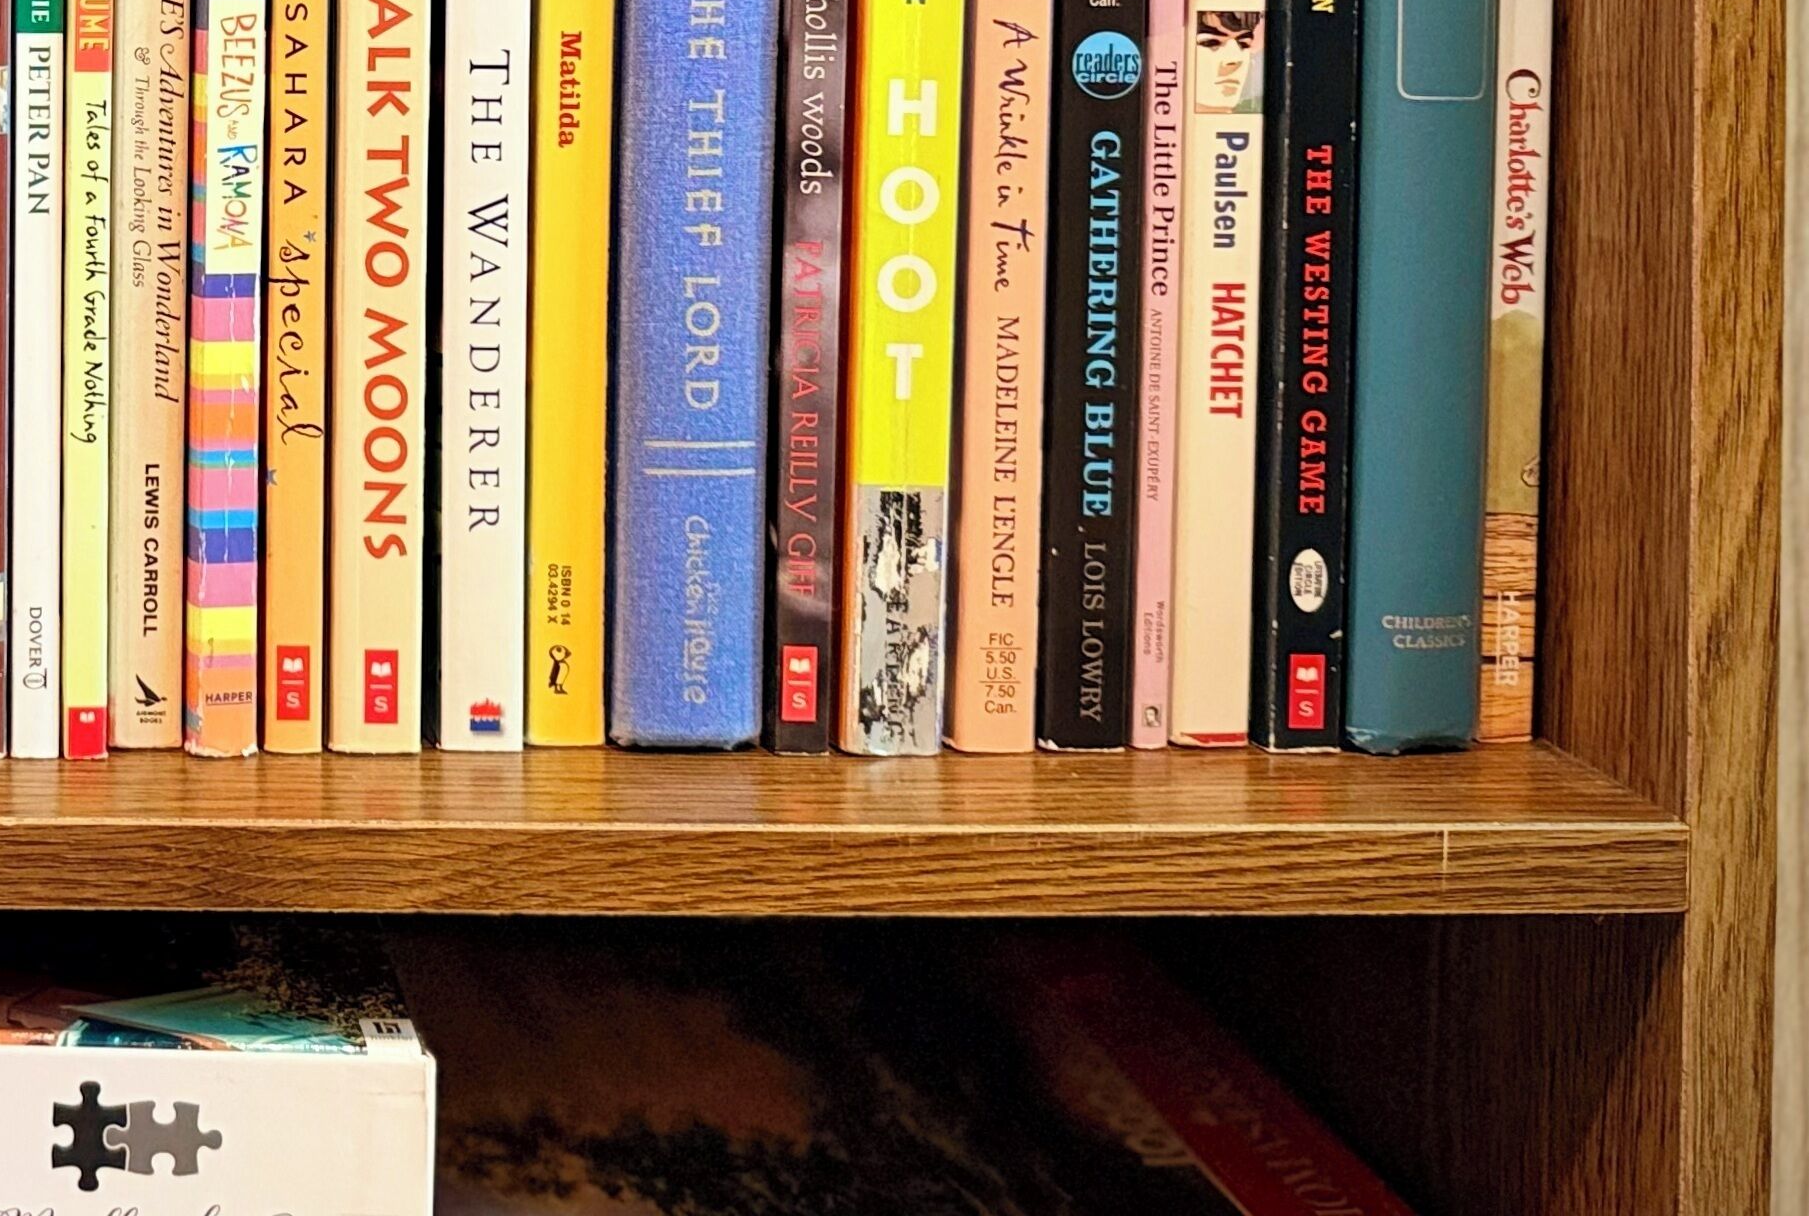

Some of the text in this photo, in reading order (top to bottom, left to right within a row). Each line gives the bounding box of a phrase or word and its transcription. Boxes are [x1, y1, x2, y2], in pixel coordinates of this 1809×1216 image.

[28, 45, 51, 215] PETER PAN
[158, 44, 185, 195] Adventures
[284, 2, 308, 204] SAHARA
[558, 31, 583, 148] Matilda
[1076, 44, 1140, 74] readers
[1076, 71, 1138, 85] circle
[128, 75, 152, 288] Through the Looking Glass
[213, 13, 258, 251] BEEZUS RAMONA
[683, 89, 726, 247] THIEF
[800, 91, 833, 196] woods
[990, 18, 1040, 292] A Wrinkle in Time
[1151, 62, 1179, 298] The Little Prince
[1213, 131, 1250, 249] Paulsen
[1499, 68, 1545, 305] Charlotte's Web
[70, 100, 110, 444] Tales of a Fourth Grade Nothing
[158, 207, 182, 235] in
[364, 135, 410, 288] TWO
[877, 78, 940, 401] HOOT
[154, 239, 181, 403] Wonderland
[467, 49, 511, 532] THE WANDERER
[683, 275, 722, 411] LORD
[1082, 129, 1122, 518] GATHERING BLUE
[1148, 308, 1163, 392] ANTOINE DE
[1209, 282, 1246, 419] HATCHET
[1299, 144, 1333, 515] THE WESTING GAME
[363, 307, 409, 559] MOONS
[783, 240, 825, 599] PATRICIA REILLY GIFF
[991, 316, 1020, 609] MADELEINE L'ENGLE
[143, 463, 160, 637] LEWIS CARROLL
[561, 565, 572, 626] ISBN 14
[28, 606, 43, 668] DOVER
[205, 691, 253, 704] HARPER
[984, 685, 1016, 698] 7.50
[985, 651, 1016, 664] 5.50
[986, 667, 1017, 680] U.S.
[989, 633, 1014, 647] FIC
[1079, 542, 1107, 724] LOIS LOWRY
[1143, 611, 1152, 655] Editions
[1155, 600, 1165, 664] Wordsworth
[1392, 634, 1466, 649] CLASSICS
[1505, 591, 1520, 686] HARPER
[984, 700, 1017, 714] Can.
